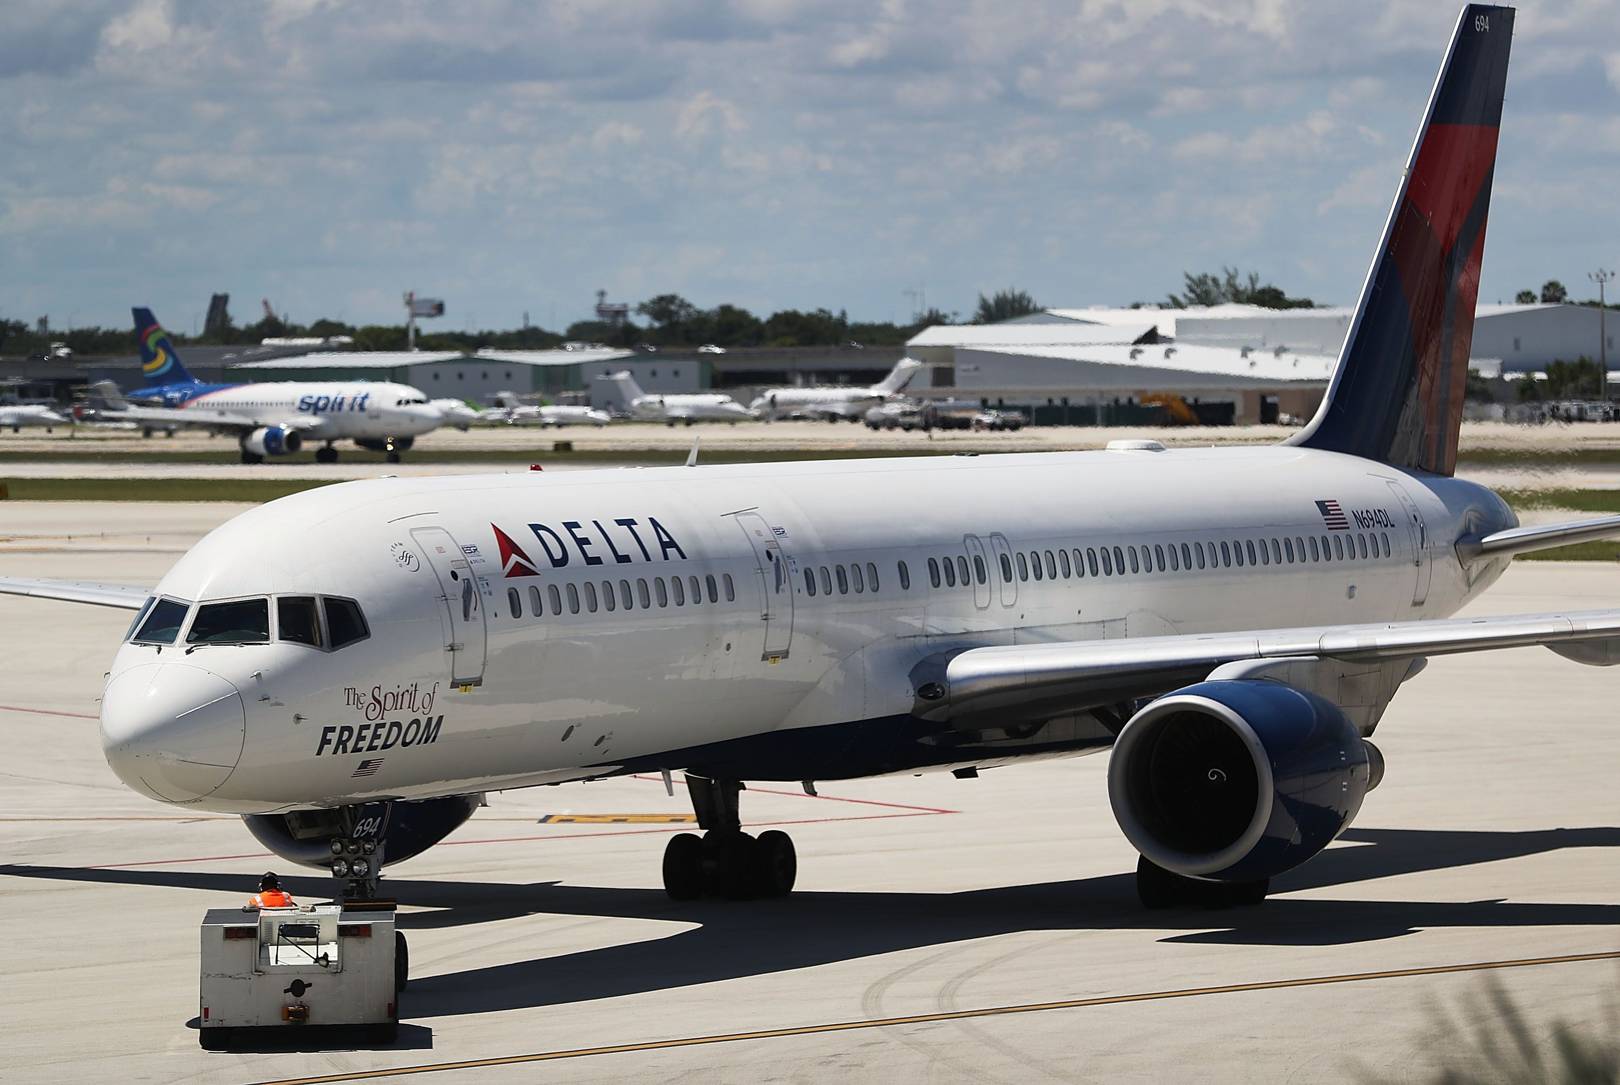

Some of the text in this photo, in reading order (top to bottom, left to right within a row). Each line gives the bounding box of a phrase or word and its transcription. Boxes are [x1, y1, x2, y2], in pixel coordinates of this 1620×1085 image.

[1475, 15, 1490, 32] 694
[297, 391, 369, 414] spirit
[1351, 508, 1395, 529] N694DL
[527, 516, 687, 568] DELTA
[344, 682, 440, 721] The Spirit of
[315, 715, 444, 756] FREEDOM
[353, 816, 382, 839] 694
